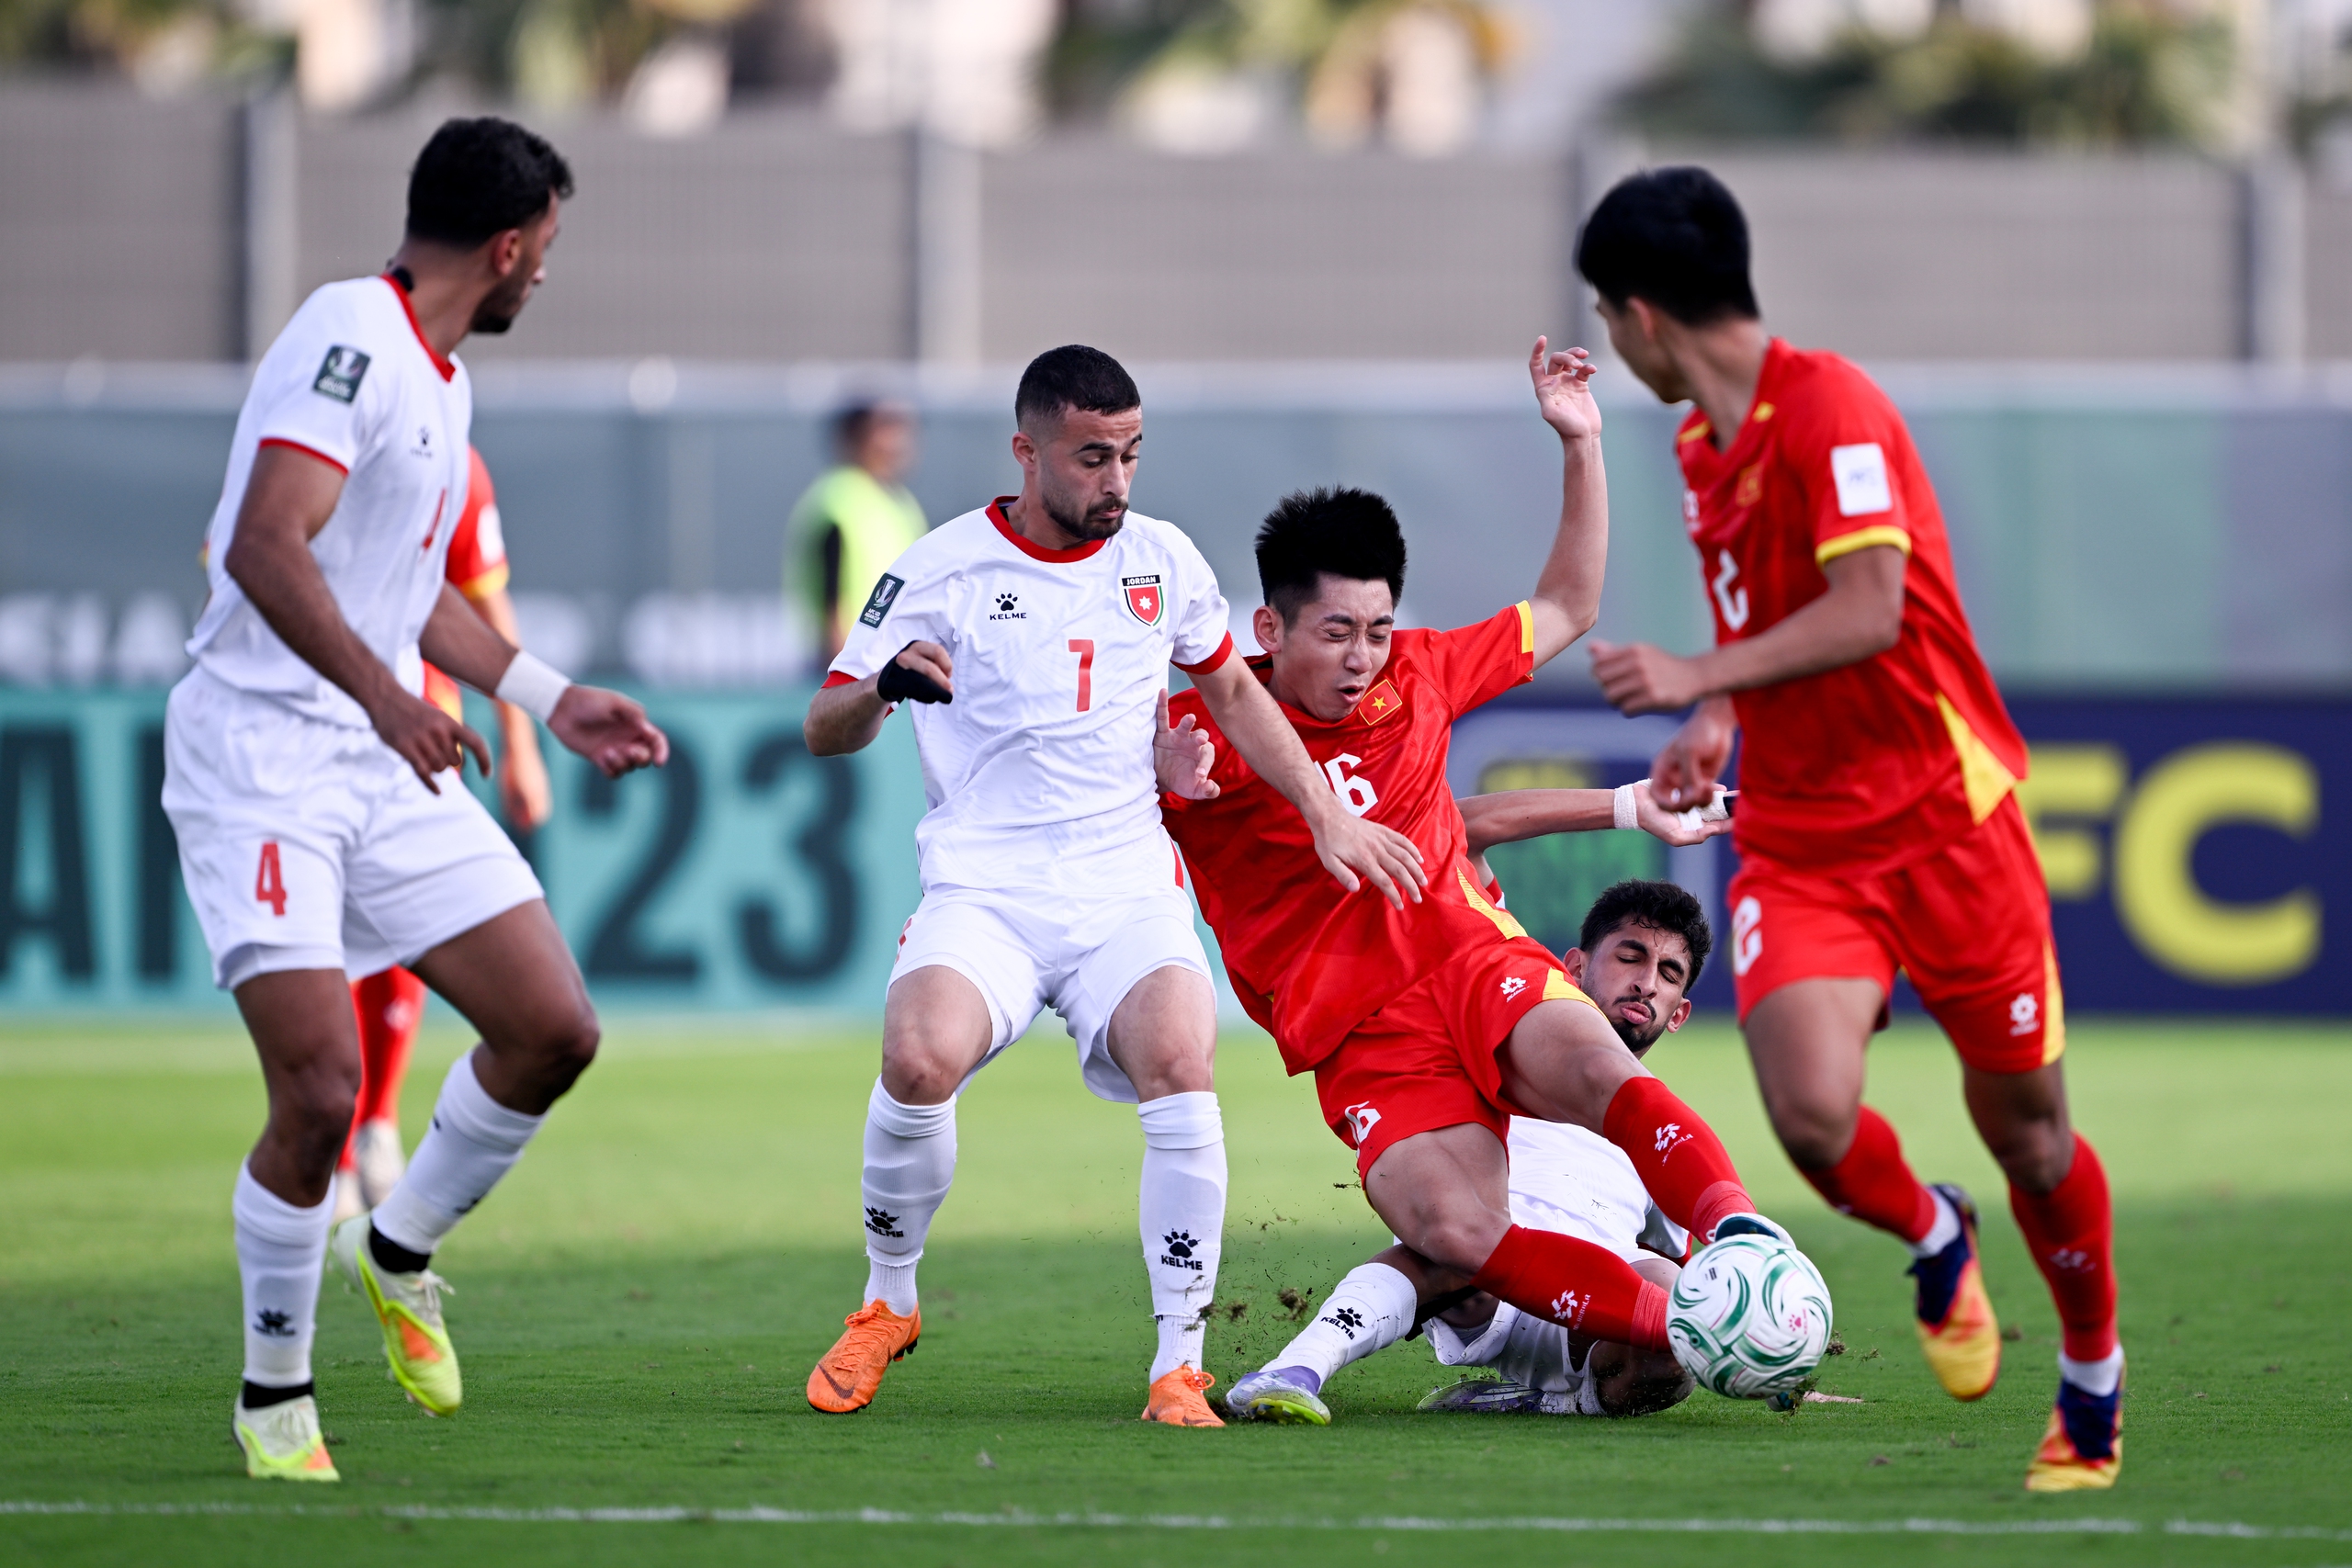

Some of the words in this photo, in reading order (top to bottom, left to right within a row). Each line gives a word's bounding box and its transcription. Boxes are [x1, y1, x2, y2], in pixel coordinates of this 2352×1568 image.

[1126, 575, 1158, 586] JORDAN
[989, 612, 1027, 621] KELME
[1069, 639, 1094, 712] 7
[516, 718, 860, 985] 23
[2021, 740, 2322, 986] FC
[256, 842, 287, 916] 4
[865, 1220, 904, 1238] KELME
[1160, 1255, 1203, 1271] KELME
[1320, 1316, 1355, 1340] KELME
